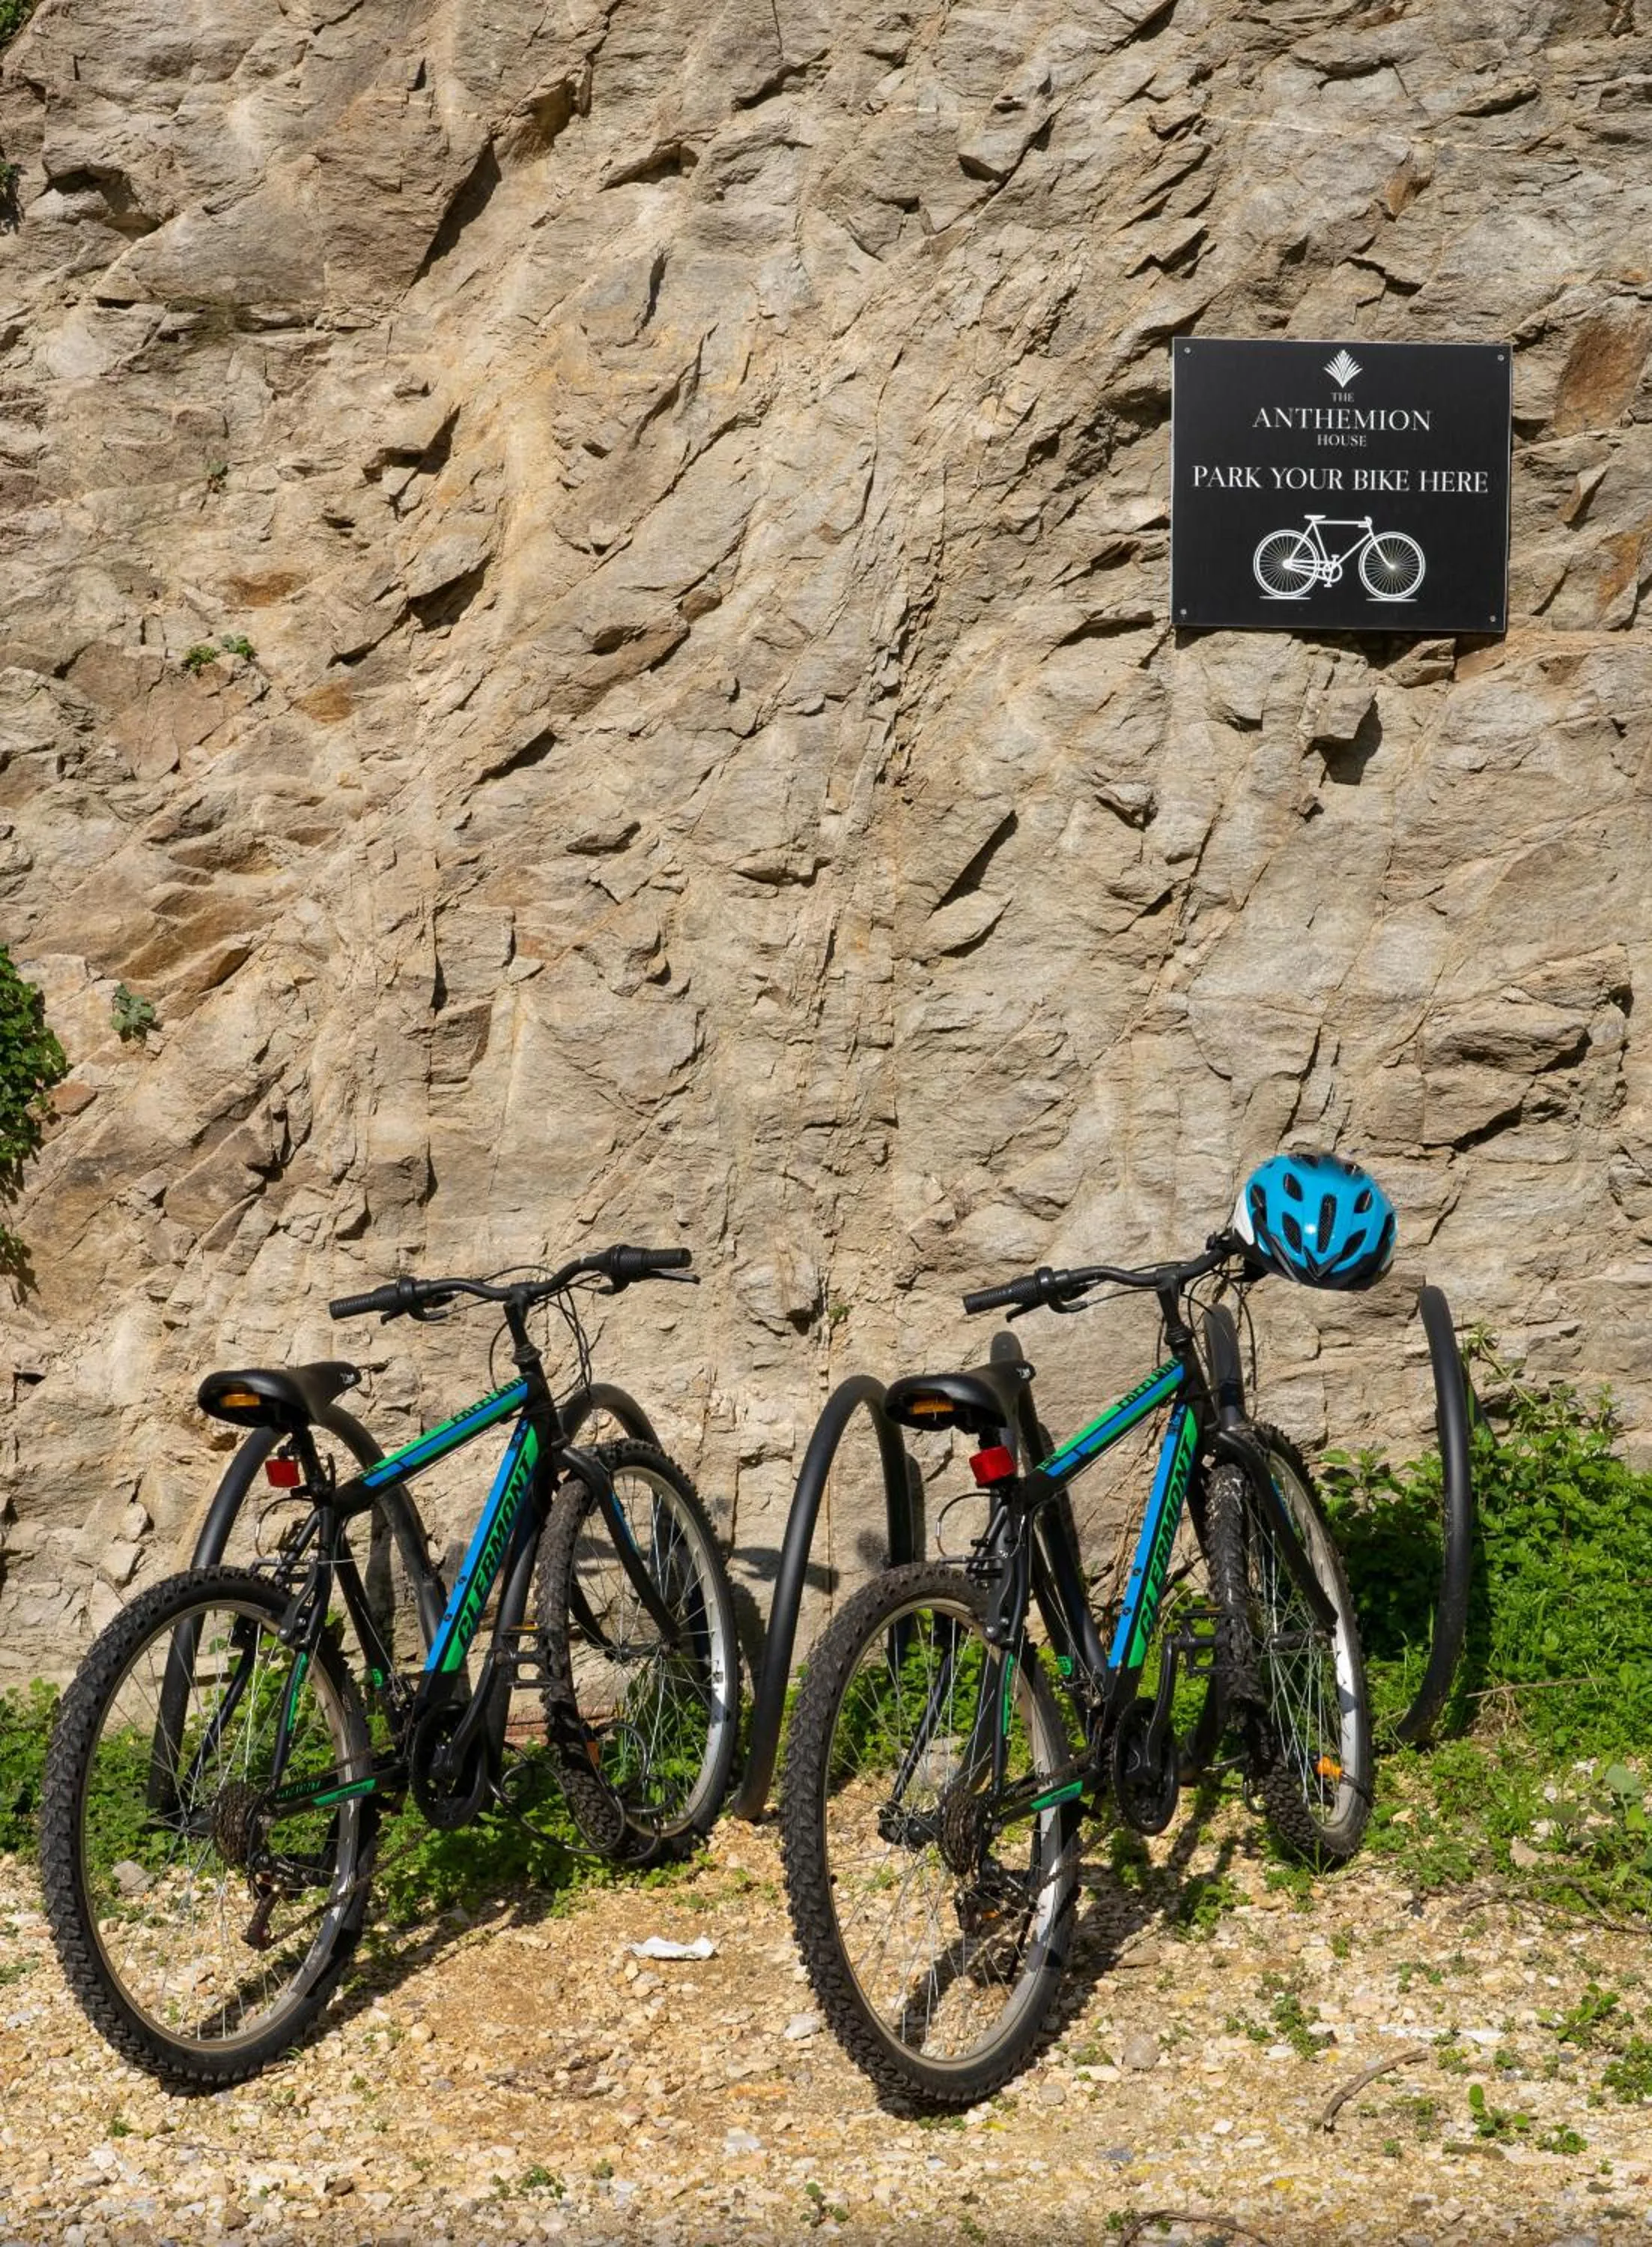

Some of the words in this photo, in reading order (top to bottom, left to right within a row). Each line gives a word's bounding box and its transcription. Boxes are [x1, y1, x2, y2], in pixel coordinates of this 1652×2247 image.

[1331, 392, 1355, 403] THE
[1252, 407, 1432, 432] ANTHEMION
[1317, 434, 1367, 447] HOUSE
[1192, 465, 1263, 489] PARK
[1269, 467, 1345, 491] YOUR
[1353, 469, 1410, 492] BIKE
[1418, 470, 1489, 494] HERE
[458, 1449, 532, 1647] CLERMONT
[1141, 1437, 1194, 1642] CLERMONT
